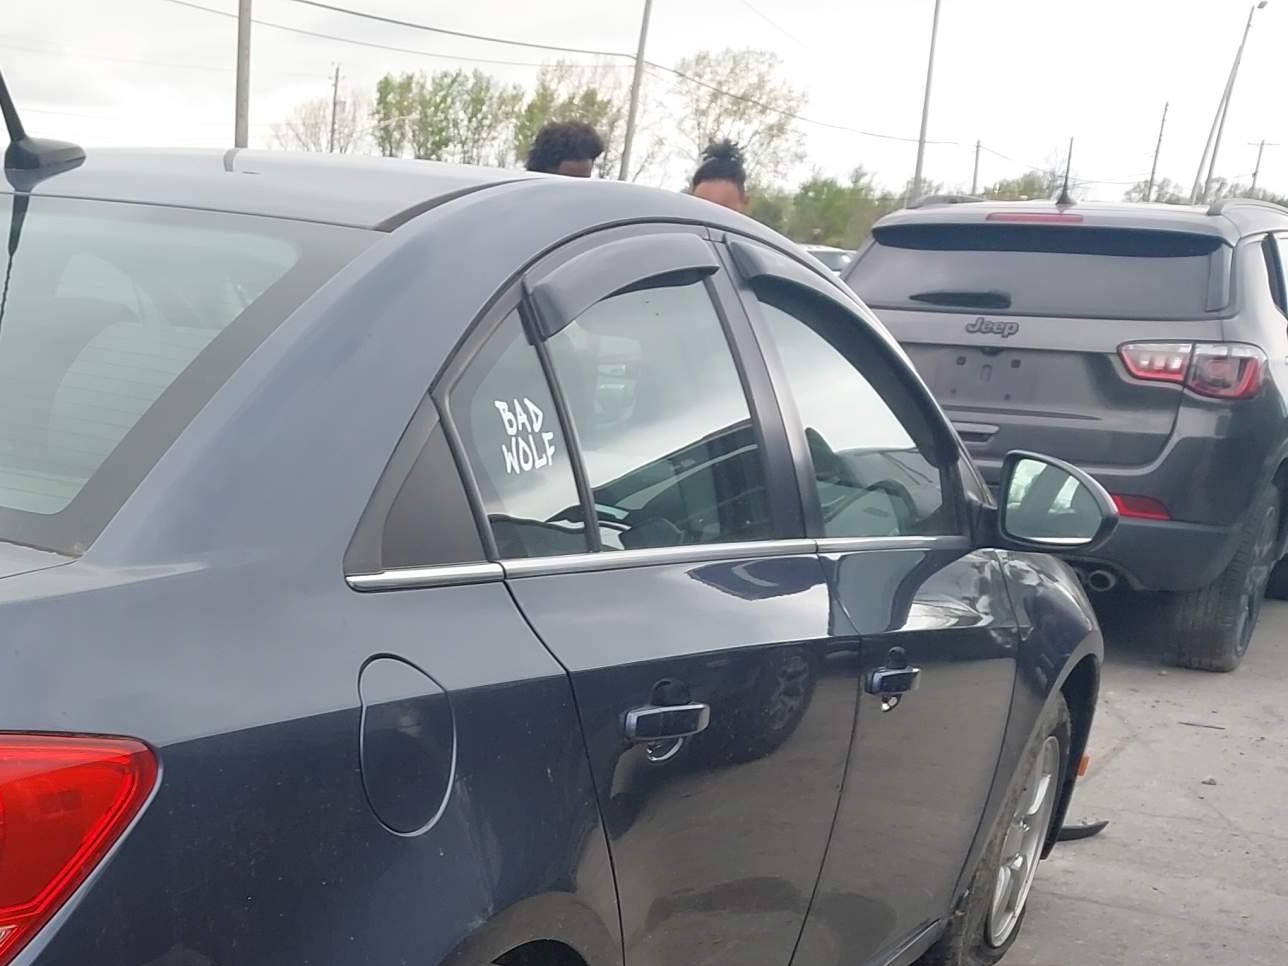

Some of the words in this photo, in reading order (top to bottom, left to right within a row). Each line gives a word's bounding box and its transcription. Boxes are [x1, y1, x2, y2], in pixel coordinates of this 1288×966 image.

[965, 316, 1020, 338] Jeep
[494, 397, 544, 436] BAD
[501, 431, 556, 475] WOLF
